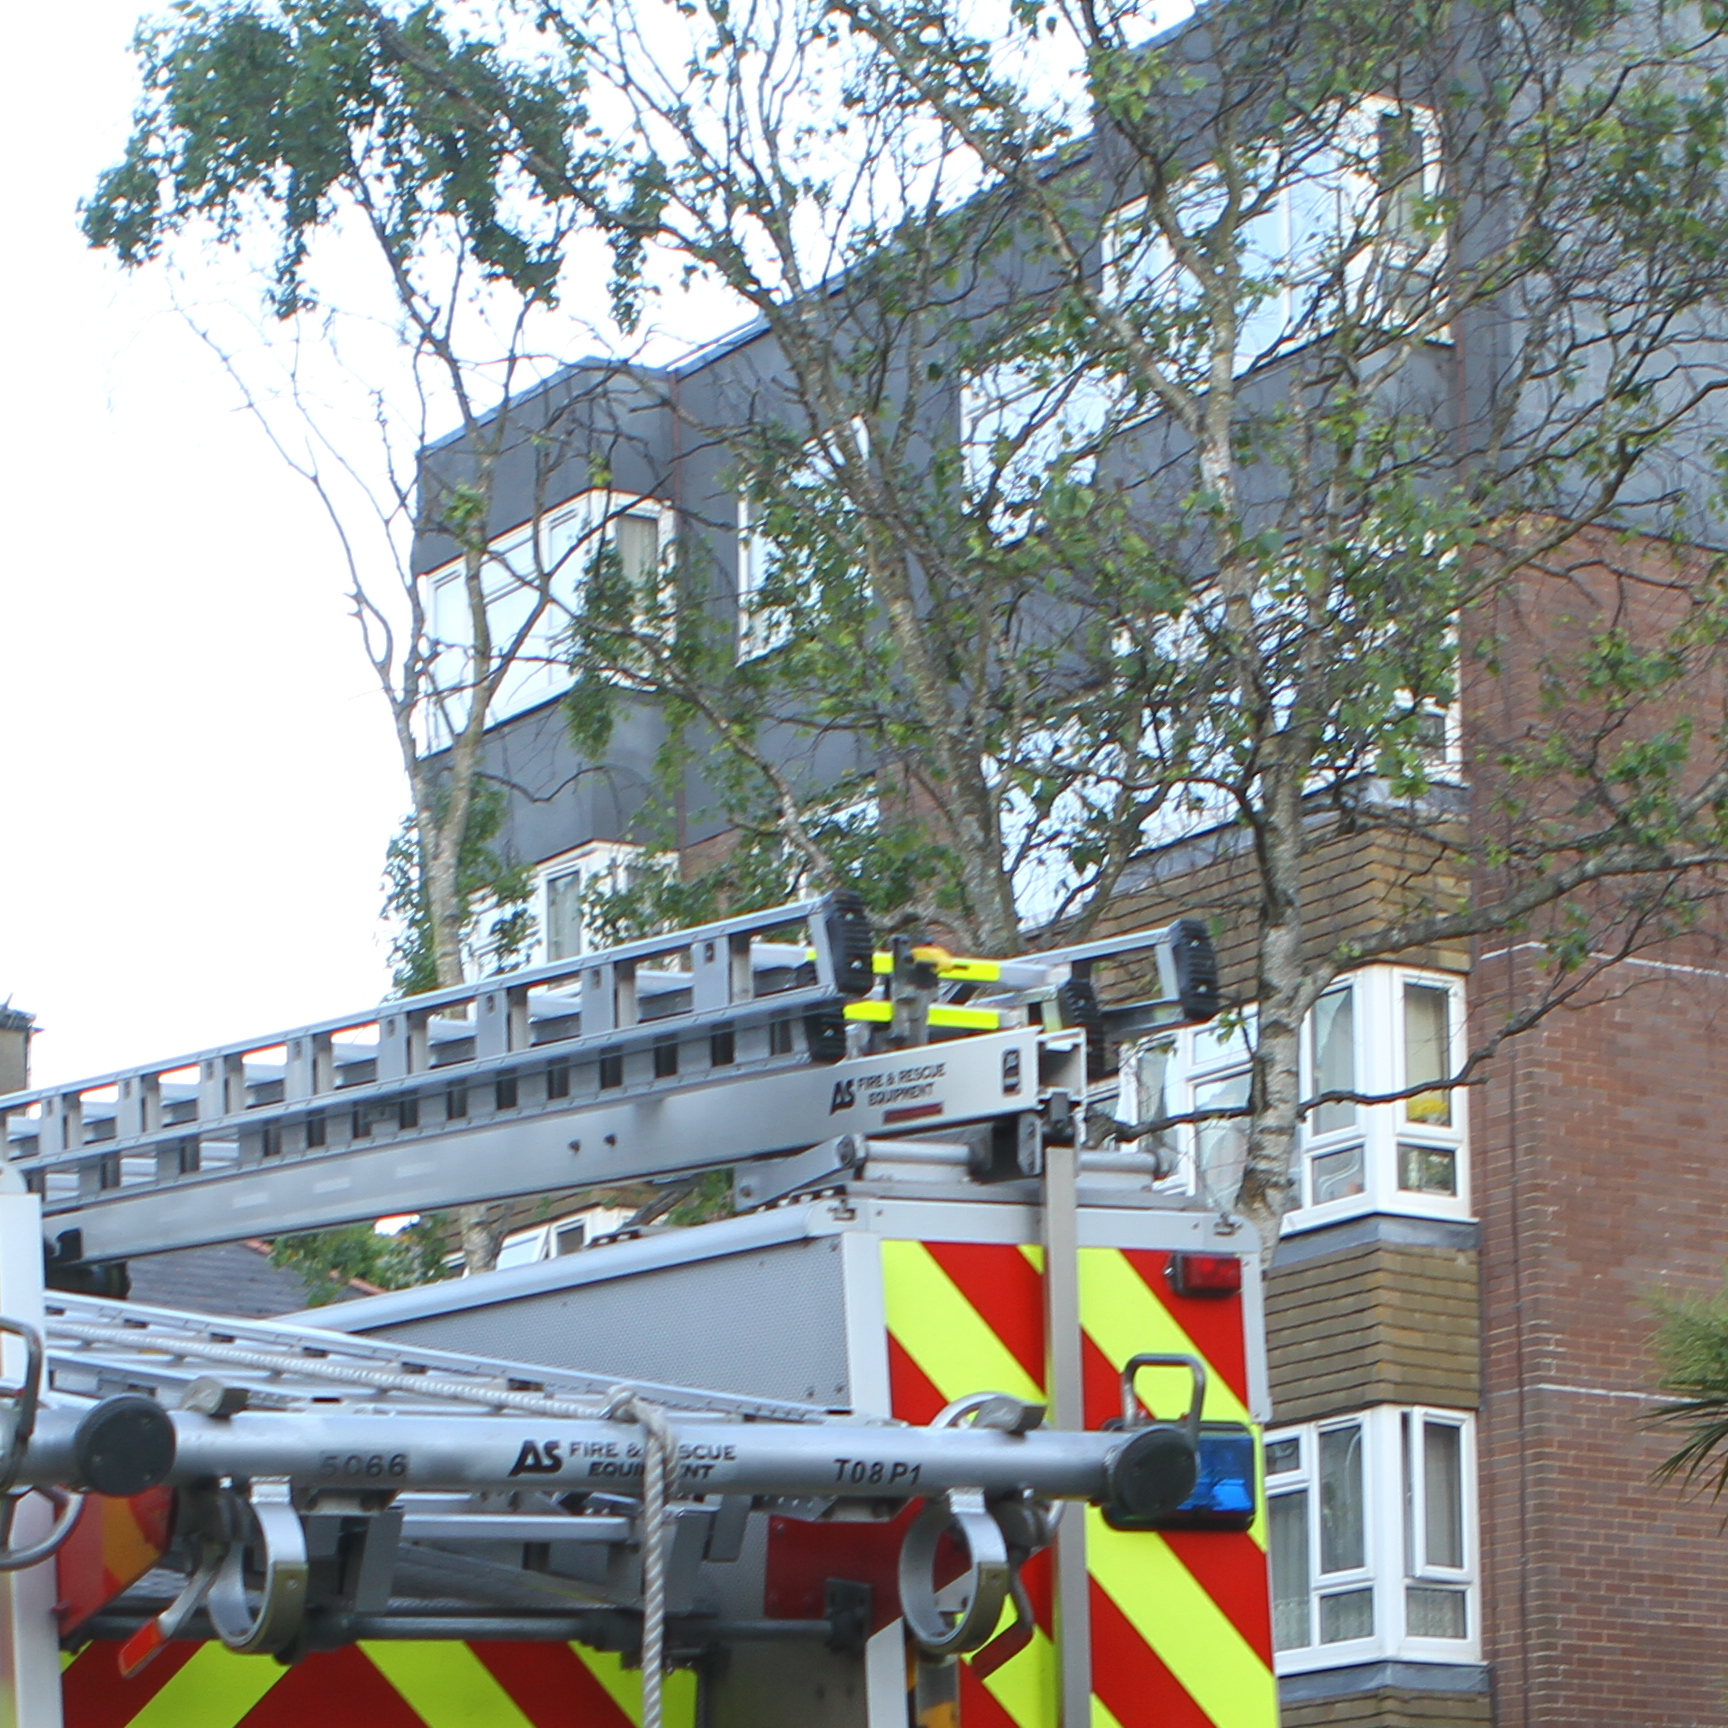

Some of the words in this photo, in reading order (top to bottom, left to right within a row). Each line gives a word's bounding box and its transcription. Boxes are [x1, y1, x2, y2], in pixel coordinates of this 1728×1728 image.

[858, 1072, 883, 1091] FIRE
[886, 1071, 895, 1085] &
[898, 1061, 946, 1083] RESCUE
[869, 1082, 934, 1106] EQUIPMENT
[507, 1440, 563, 1477] AS
[570, 1441, 619, 1458] FIRE
[626, 1441, 641, 1457] &
